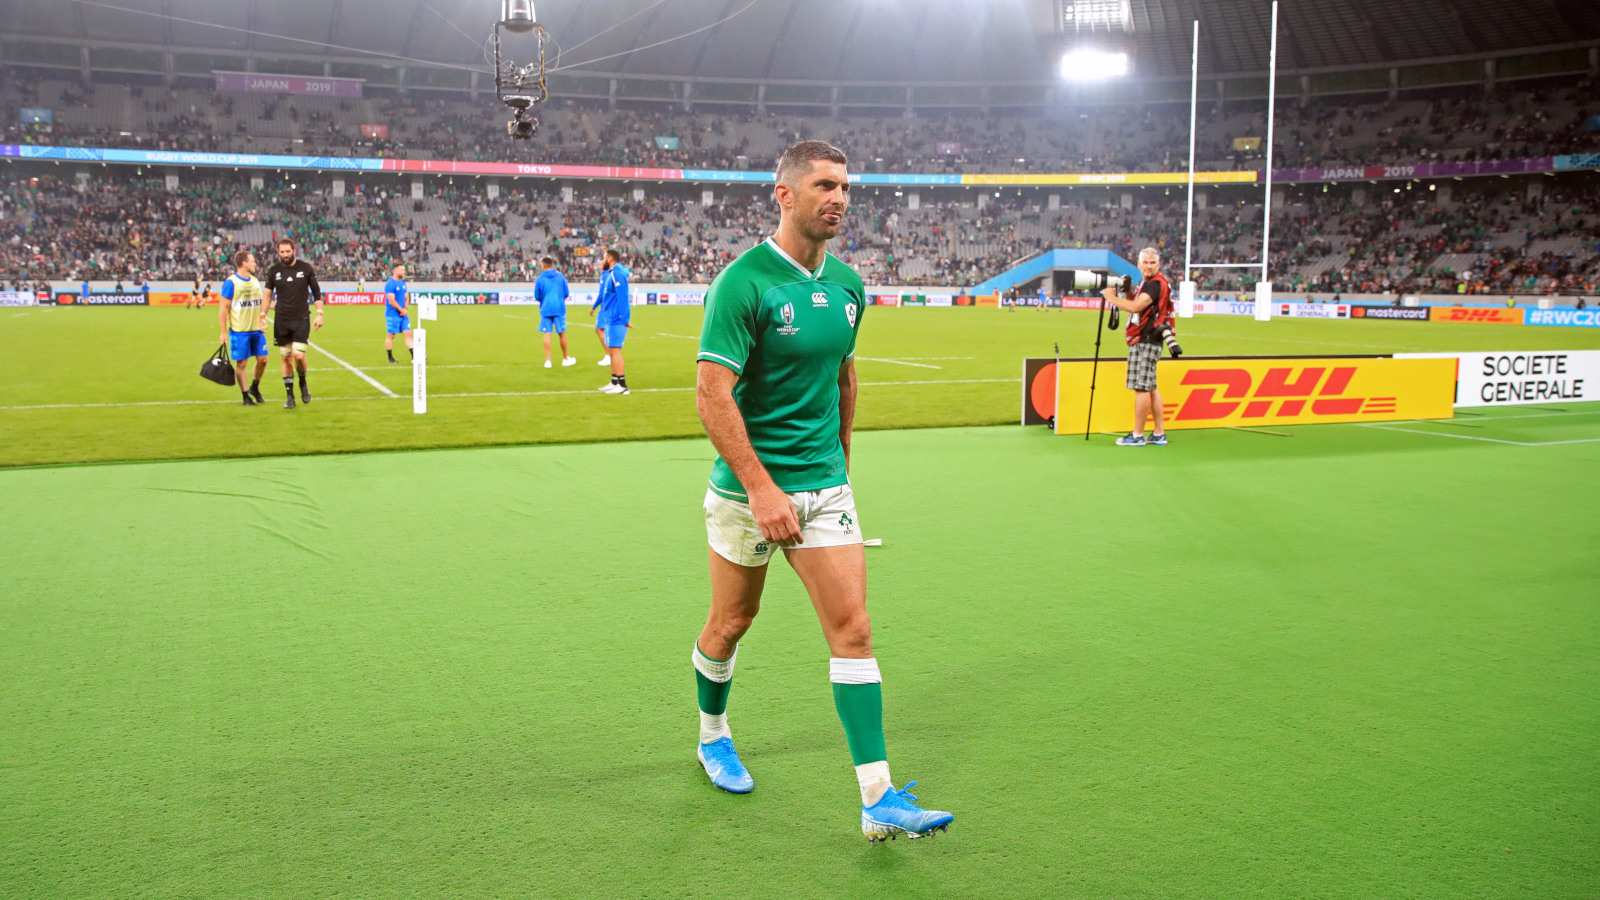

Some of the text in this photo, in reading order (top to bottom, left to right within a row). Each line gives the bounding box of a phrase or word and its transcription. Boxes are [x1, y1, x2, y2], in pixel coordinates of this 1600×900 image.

[251, 79, 331, 92] JAPAN 2019
[146, 152, 179, 161] RUGBY
[181, 154, 216, 162] WORLD
[238, 156, 258, 164] 2019
[518, 165, 551, 174] TOKYO
[1320, 166, 1415, 179] JAPAN 2019
[328, 294, 371, 304] Emirates
[1230, 303, 1256, 314] TOT
[1367, 308, 1427, 319] mastercard
[1450, 309, 1503, 322] DHL
[1483, 355, 1568, 376] SOCIETE
[1175, 367, 1366, 421] DHL
[1481, 379, 1584, 402] GENERALE
